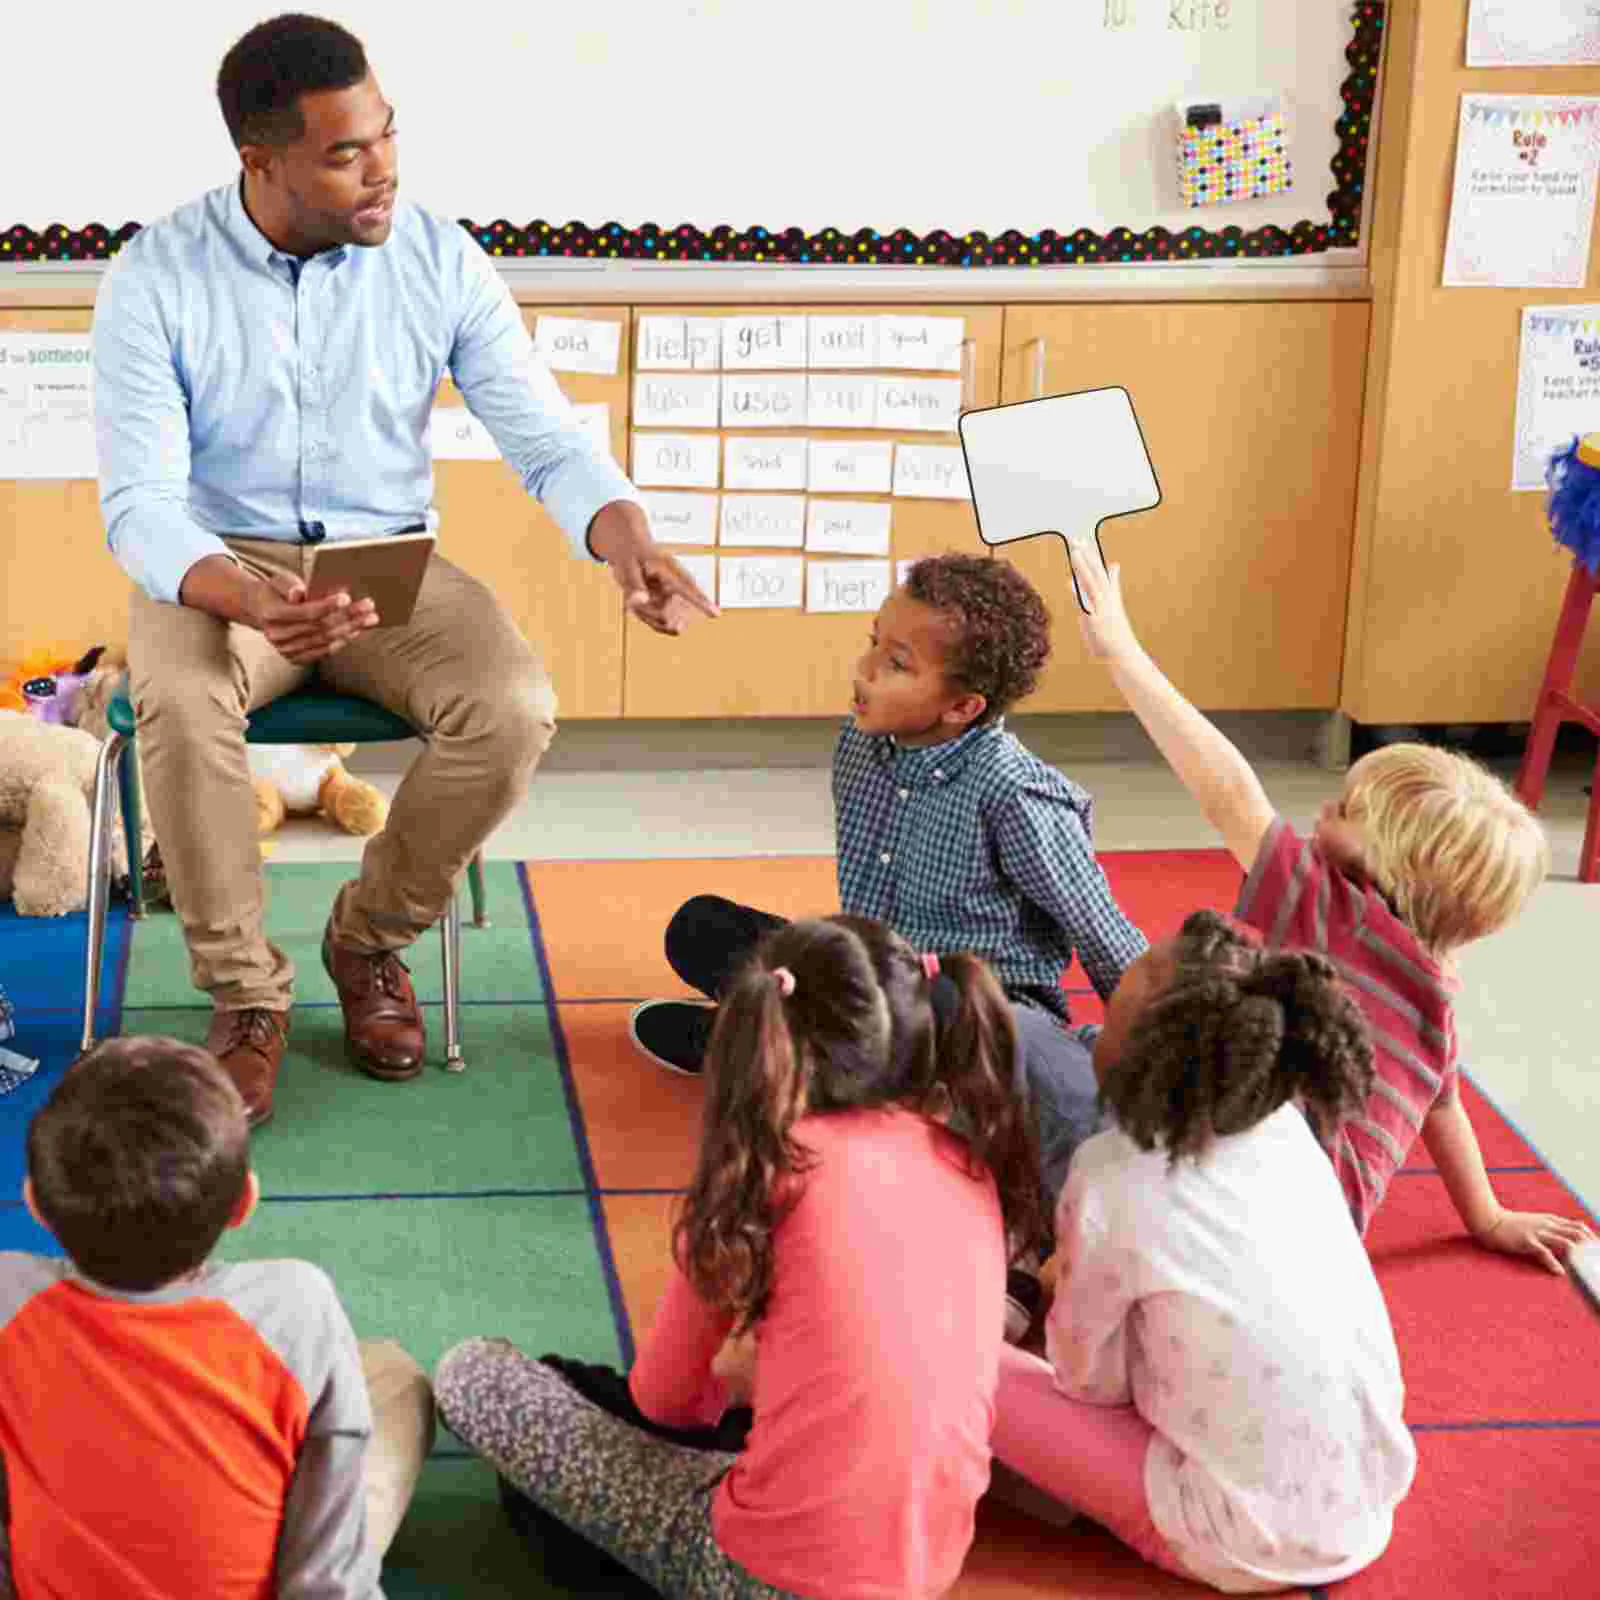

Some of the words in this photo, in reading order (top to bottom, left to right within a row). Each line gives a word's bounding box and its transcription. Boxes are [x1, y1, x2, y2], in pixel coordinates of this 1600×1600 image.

[1512, 129, 1547, 148] Rule
[643, 320, 710, 370] help
[736, 318, 785, 359] get
[732, 391, 794, 414] use
[737, 570, 785, 600] too
[822, 568, 877, 606] her
